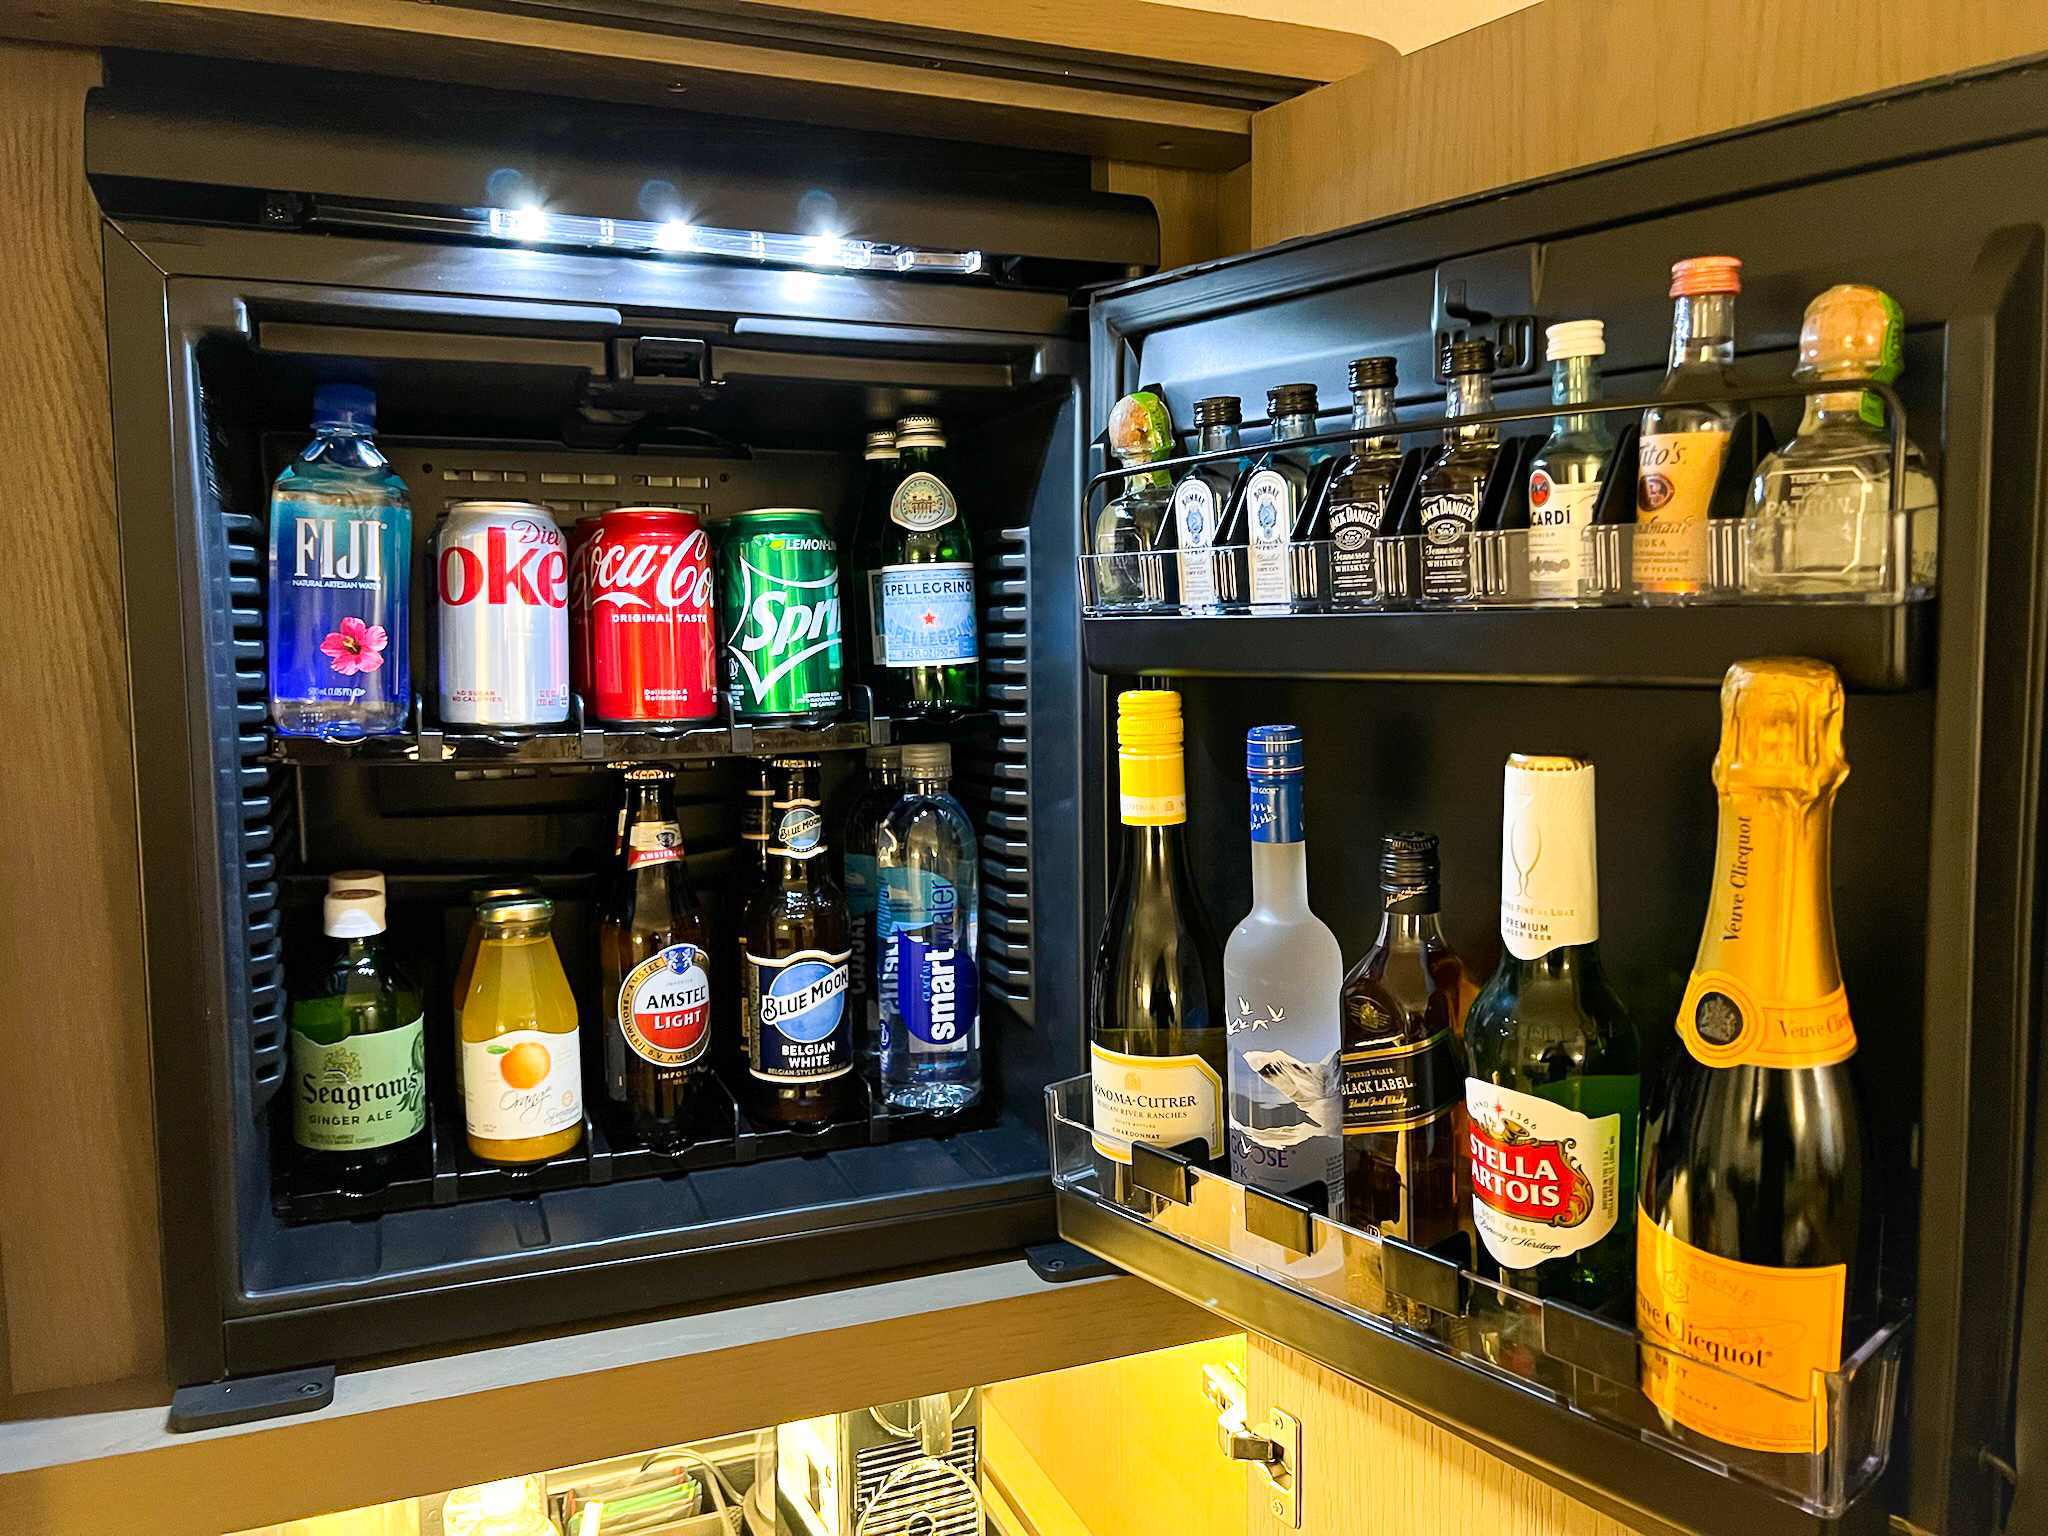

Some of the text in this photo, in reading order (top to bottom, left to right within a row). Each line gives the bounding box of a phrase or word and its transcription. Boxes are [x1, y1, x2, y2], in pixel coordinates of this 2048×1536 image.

[511, 520, 560, 546] Diet
[293, 517, 382, 581] FIJI
[1334, 563, 1371, 573] WHISKEY
[1426, 558, 1465, 568] WHISKEY
[292, 579, 382, 591] NATURAL ARTESIAN WATER
[611, 613, 708, 623] ORIGINAL TASTE
[741, 590, 842, 656] Spri
[644, 688, 682, 696] Delicious
[645, 694, 688, 702] Refreshing
[780, 825, 802, 840] BLUE
[1721, 815, 1754, 943] Veuve Clicquot
[1506, 917, 1549, 933] PREMIUM
[1528, 932, 1552, 941] BEER
[628, 961, 660, 990] AMSTEL
[646, 985, 706, 1010] AMSTEL
[763, 968, 848, 1021] BLUE MOON
[653, 1009, 702, 1030] LIGHT
[1777, 1019, 1825, 1039] Veuve
[781, 1041, 836, 1056] BELGIAN
[788, 1054, 830, 1069] WHITE
[302, 1067, 418, 1110] Seagram's
[1374, 1076, 1414, 1092] LABEL
[308, 1109, 393, 1126] GINGER ALE
[1120, 1108, 1144, 1119] RIVER
[1146, 1111, 1188, 1119] RANCHES
[1510, 1109, 1537, 1131] 1366
[1112, 1126, 1161, 1140] CHARDONNAY
[1469, 1132, 1560, 1182] STELLA
[1470, 1158, 1561, 1207] ARTOIS
[1511, 1236, 1562, 1254] Heritage
[1665, 1311, 1768, 1369] Clicquot
